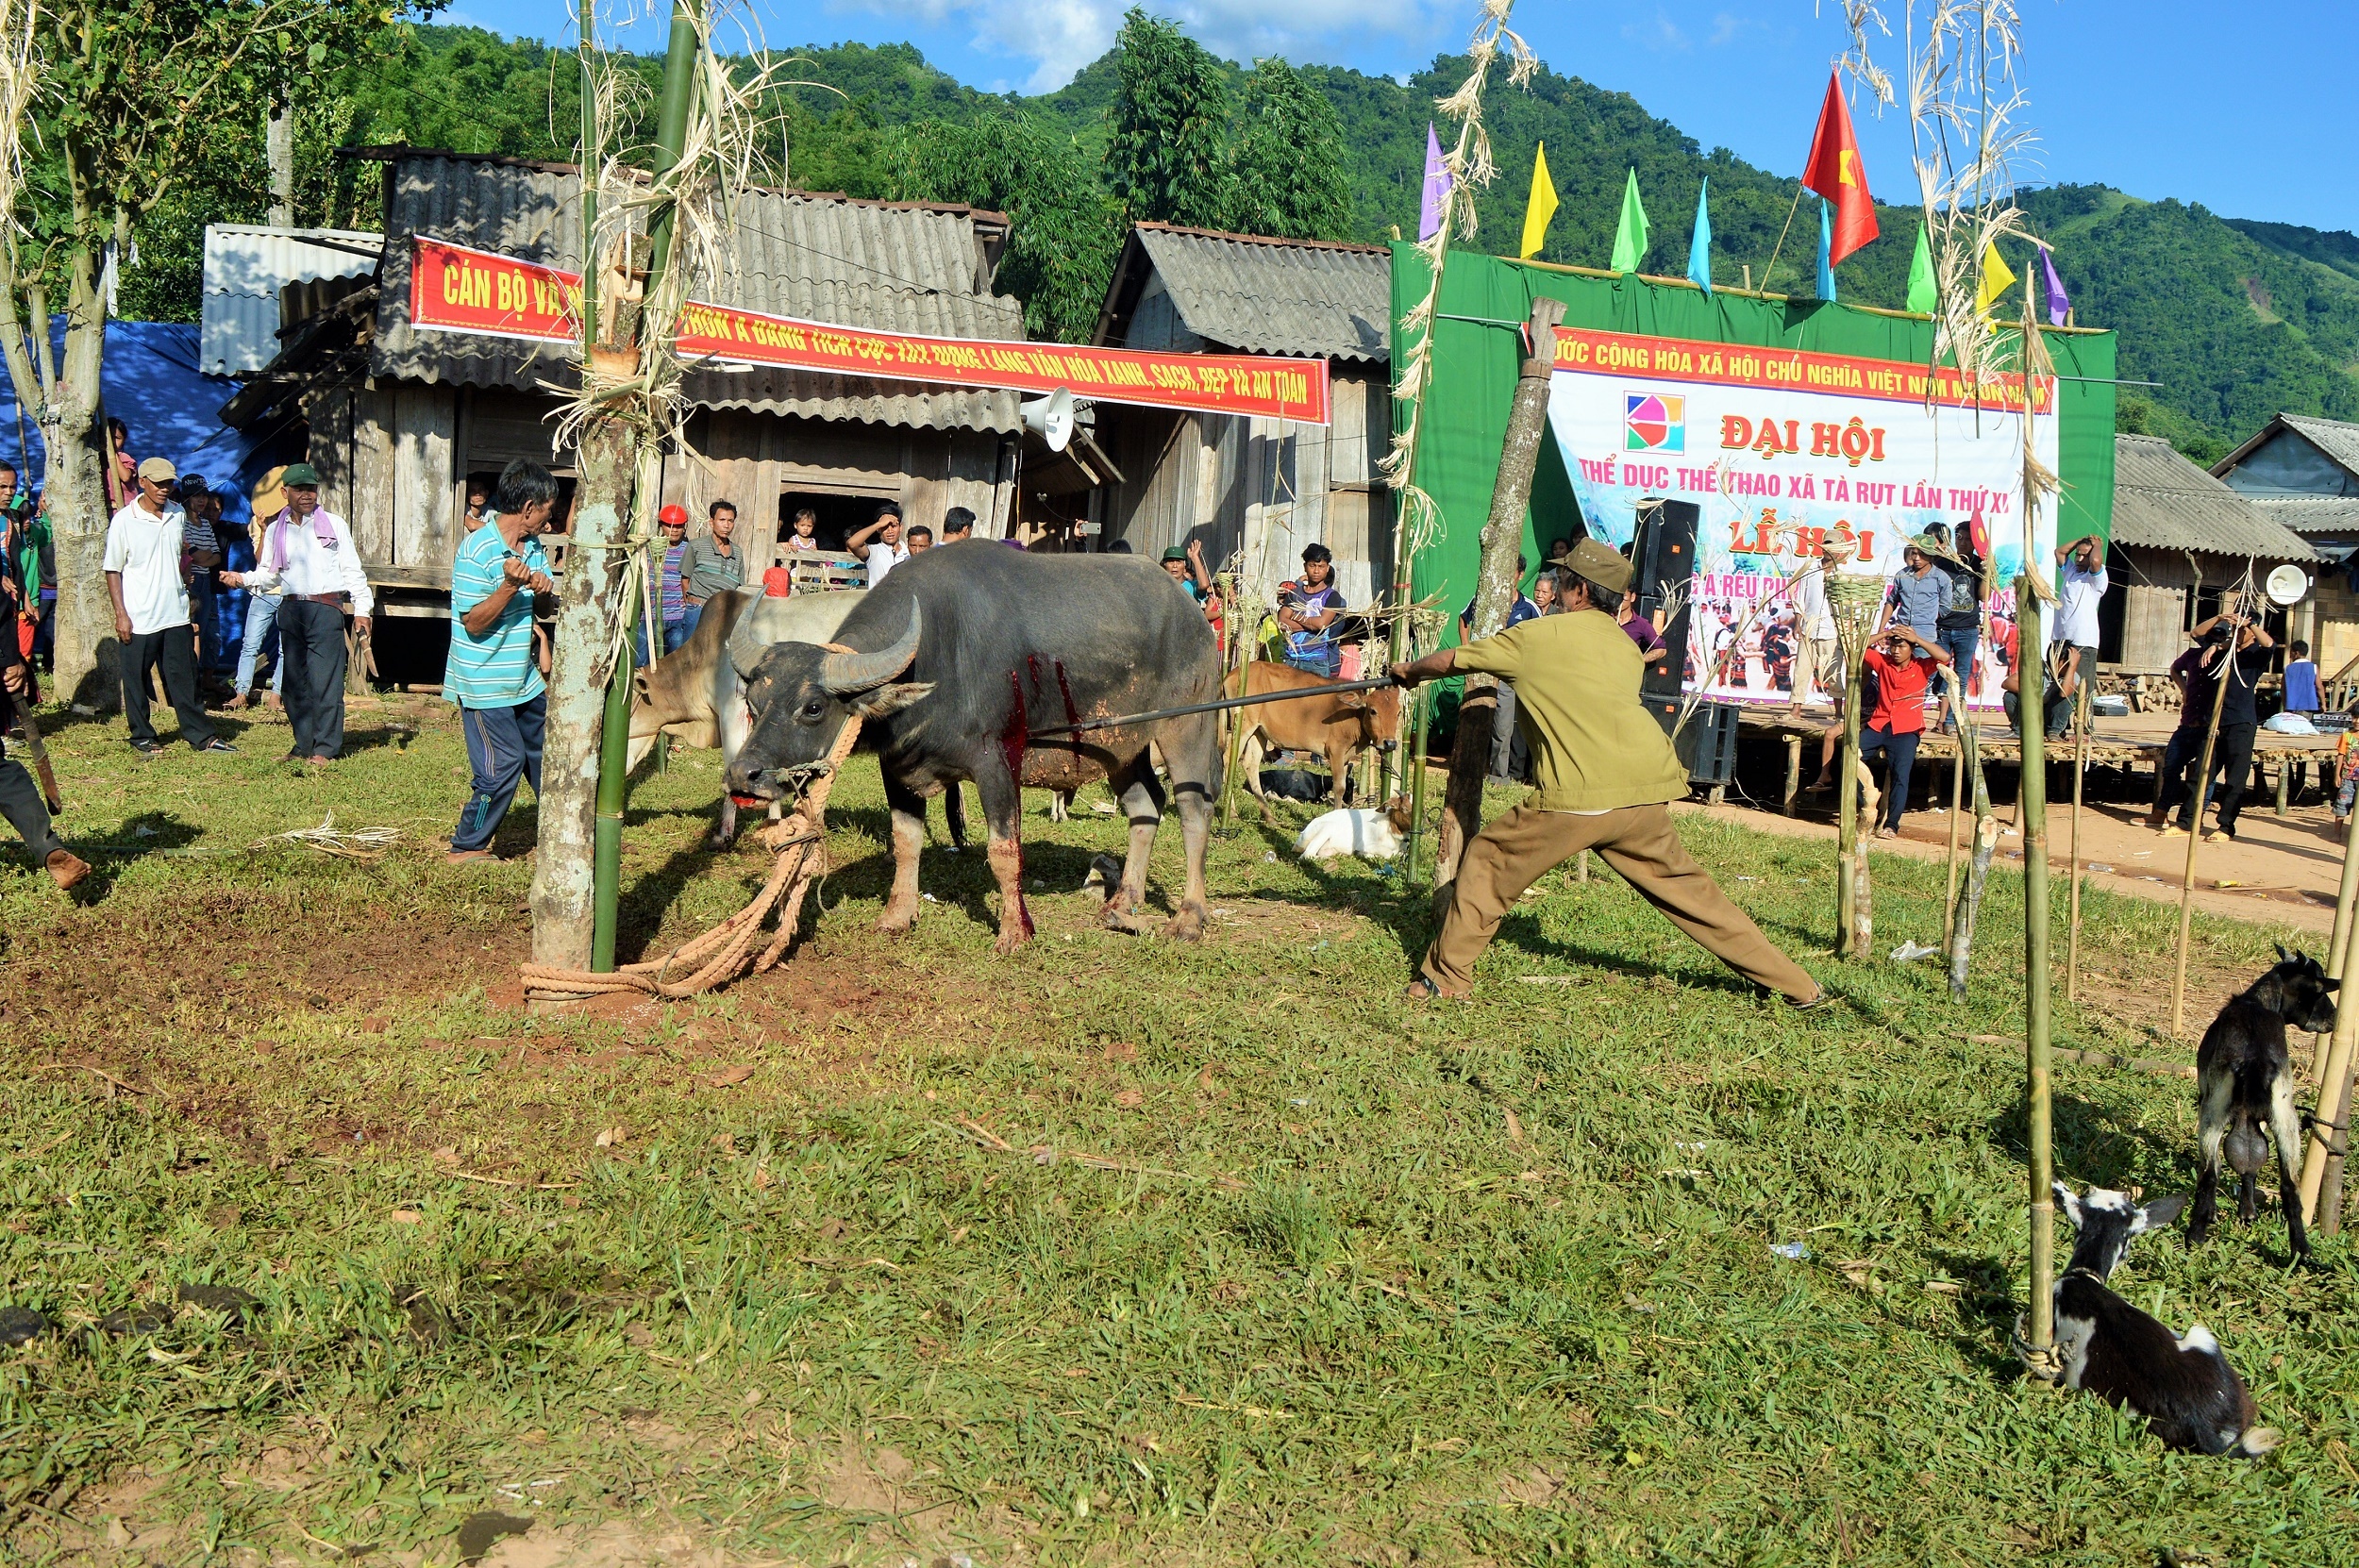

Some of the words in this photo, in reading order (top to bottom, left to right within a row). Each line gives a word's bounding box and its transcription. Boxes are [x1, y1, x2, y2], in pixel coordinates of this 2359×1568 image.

[443, 259, 490, 309] CÁN
[497, 268, 527, 322] BỘ
[532, 274, 564, 316] VÀ
[735, 316, 752, 342] A
[980, 344, 1034, 375] LÀNG
[1026, 348, 1069, 380] VĂN
[1062, 352, 1105, 384] HÓA
[1097, 359, 1156, 391] XANH,
[1149, 363, 1200, 395] SẠCH,
[1229, 364, 1251, 397] VÀ
[1251, 370, 1273, 399] AN
[1274, 367, 1308, 405] TOÀN
[1554, 335, 1589, 363] ƯỚC
[1595, 342, 1649, 371] CỘNG
[1654, 346, 1693, 374] HÒA
[1698, 352, 1724, 375] XÃ
[1729, 354, 1760, 382] HỘI
[1807, 364, 1864, 389] NGHĨA
[1865, 368, 1903, 396] VIỆT
[1908, 375, 1948, 397] NAM
[1720, 414, 1800, 460] ĐẠI
[1809, 416, 1886, 467] HỘI
[1578, 453, 1616, 485] THỂ
[1624, 463, 1669, 492] DỤC
[1677, 460, 1718, 492] THỂ
[1728, 471, 1782, 497] THAO
[1788, 473, 1816, 500] XÃ
[1823, 475, 1849, 503] TÀ
[1856, 481, 1897, 510] RỤT
[1901, 477, 1942, 509] LẦN
[1949, 484, 1989, 513] THỨ
[1729, 508, 1782, 556] LỄ
[1722, 571, 1757, 599] RÊU
